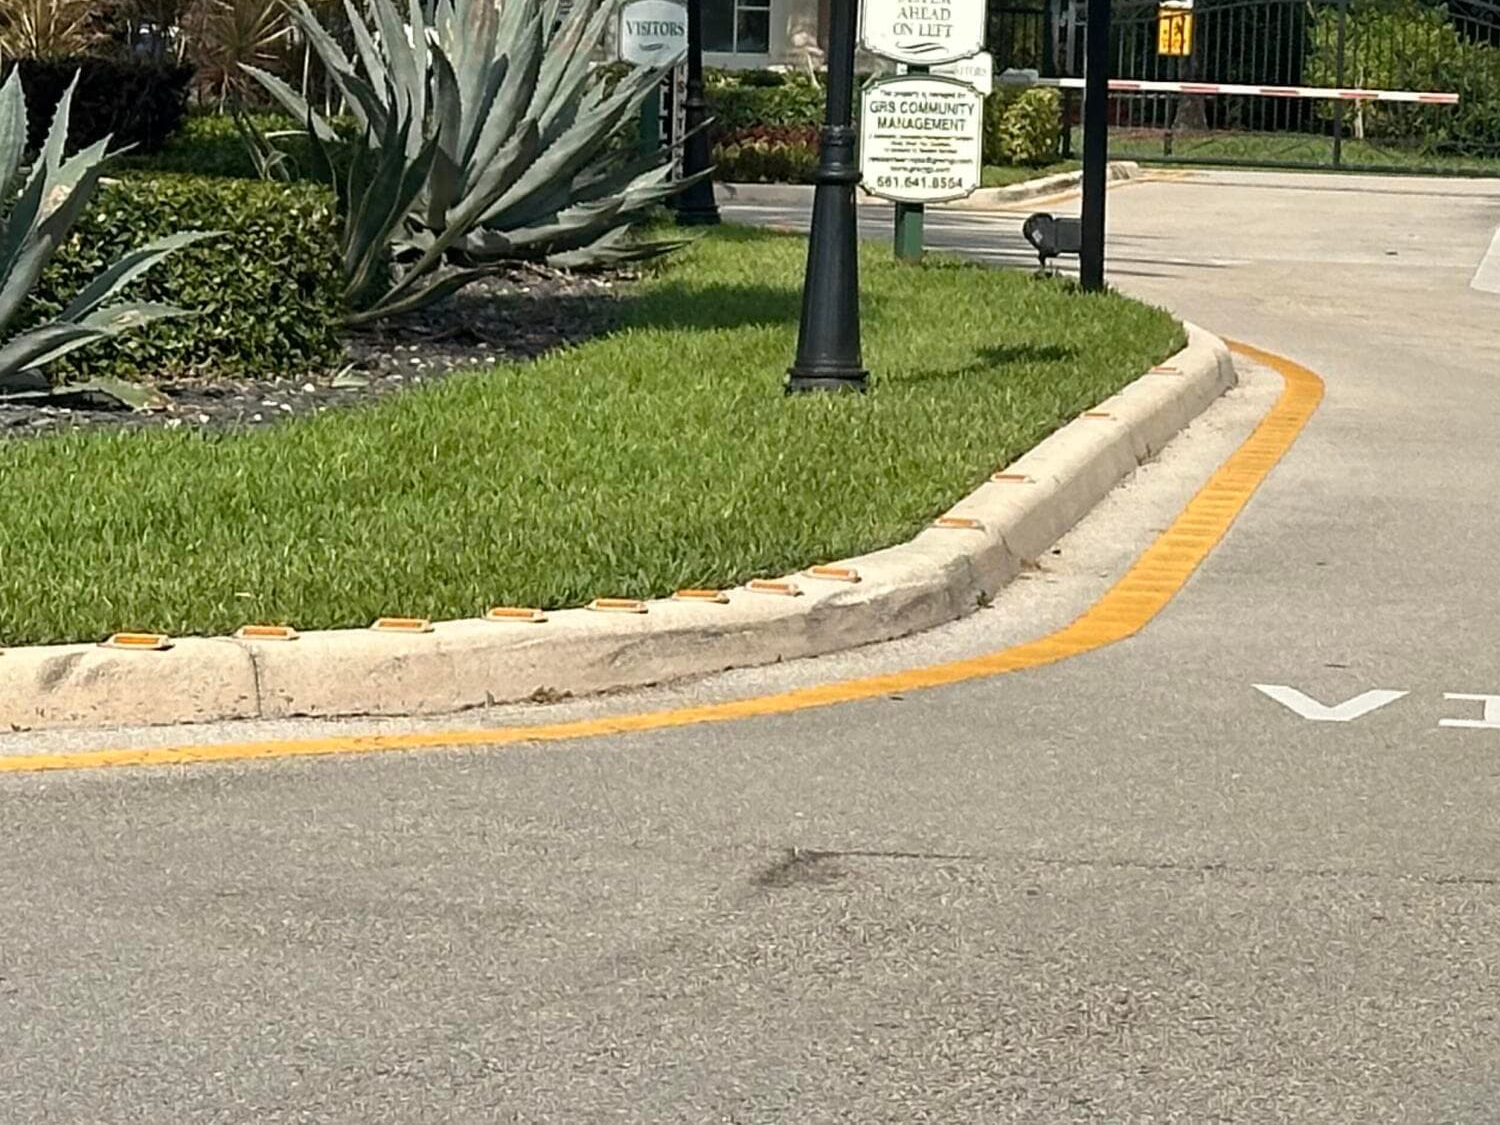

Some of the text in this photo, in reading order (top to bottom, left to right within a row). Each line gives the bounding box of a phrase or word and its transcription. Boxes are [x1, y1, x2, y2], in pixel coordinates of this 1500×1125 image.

[897, 5, 951, 21] AHEAD
[626, 19, 685, 37] VISITORS
[893, 22, 954, 38] ON LEFT
[869, 100, 975, 116] GRS COMMUNITY
[877, 117, 967, 131] MANAGEMENT
